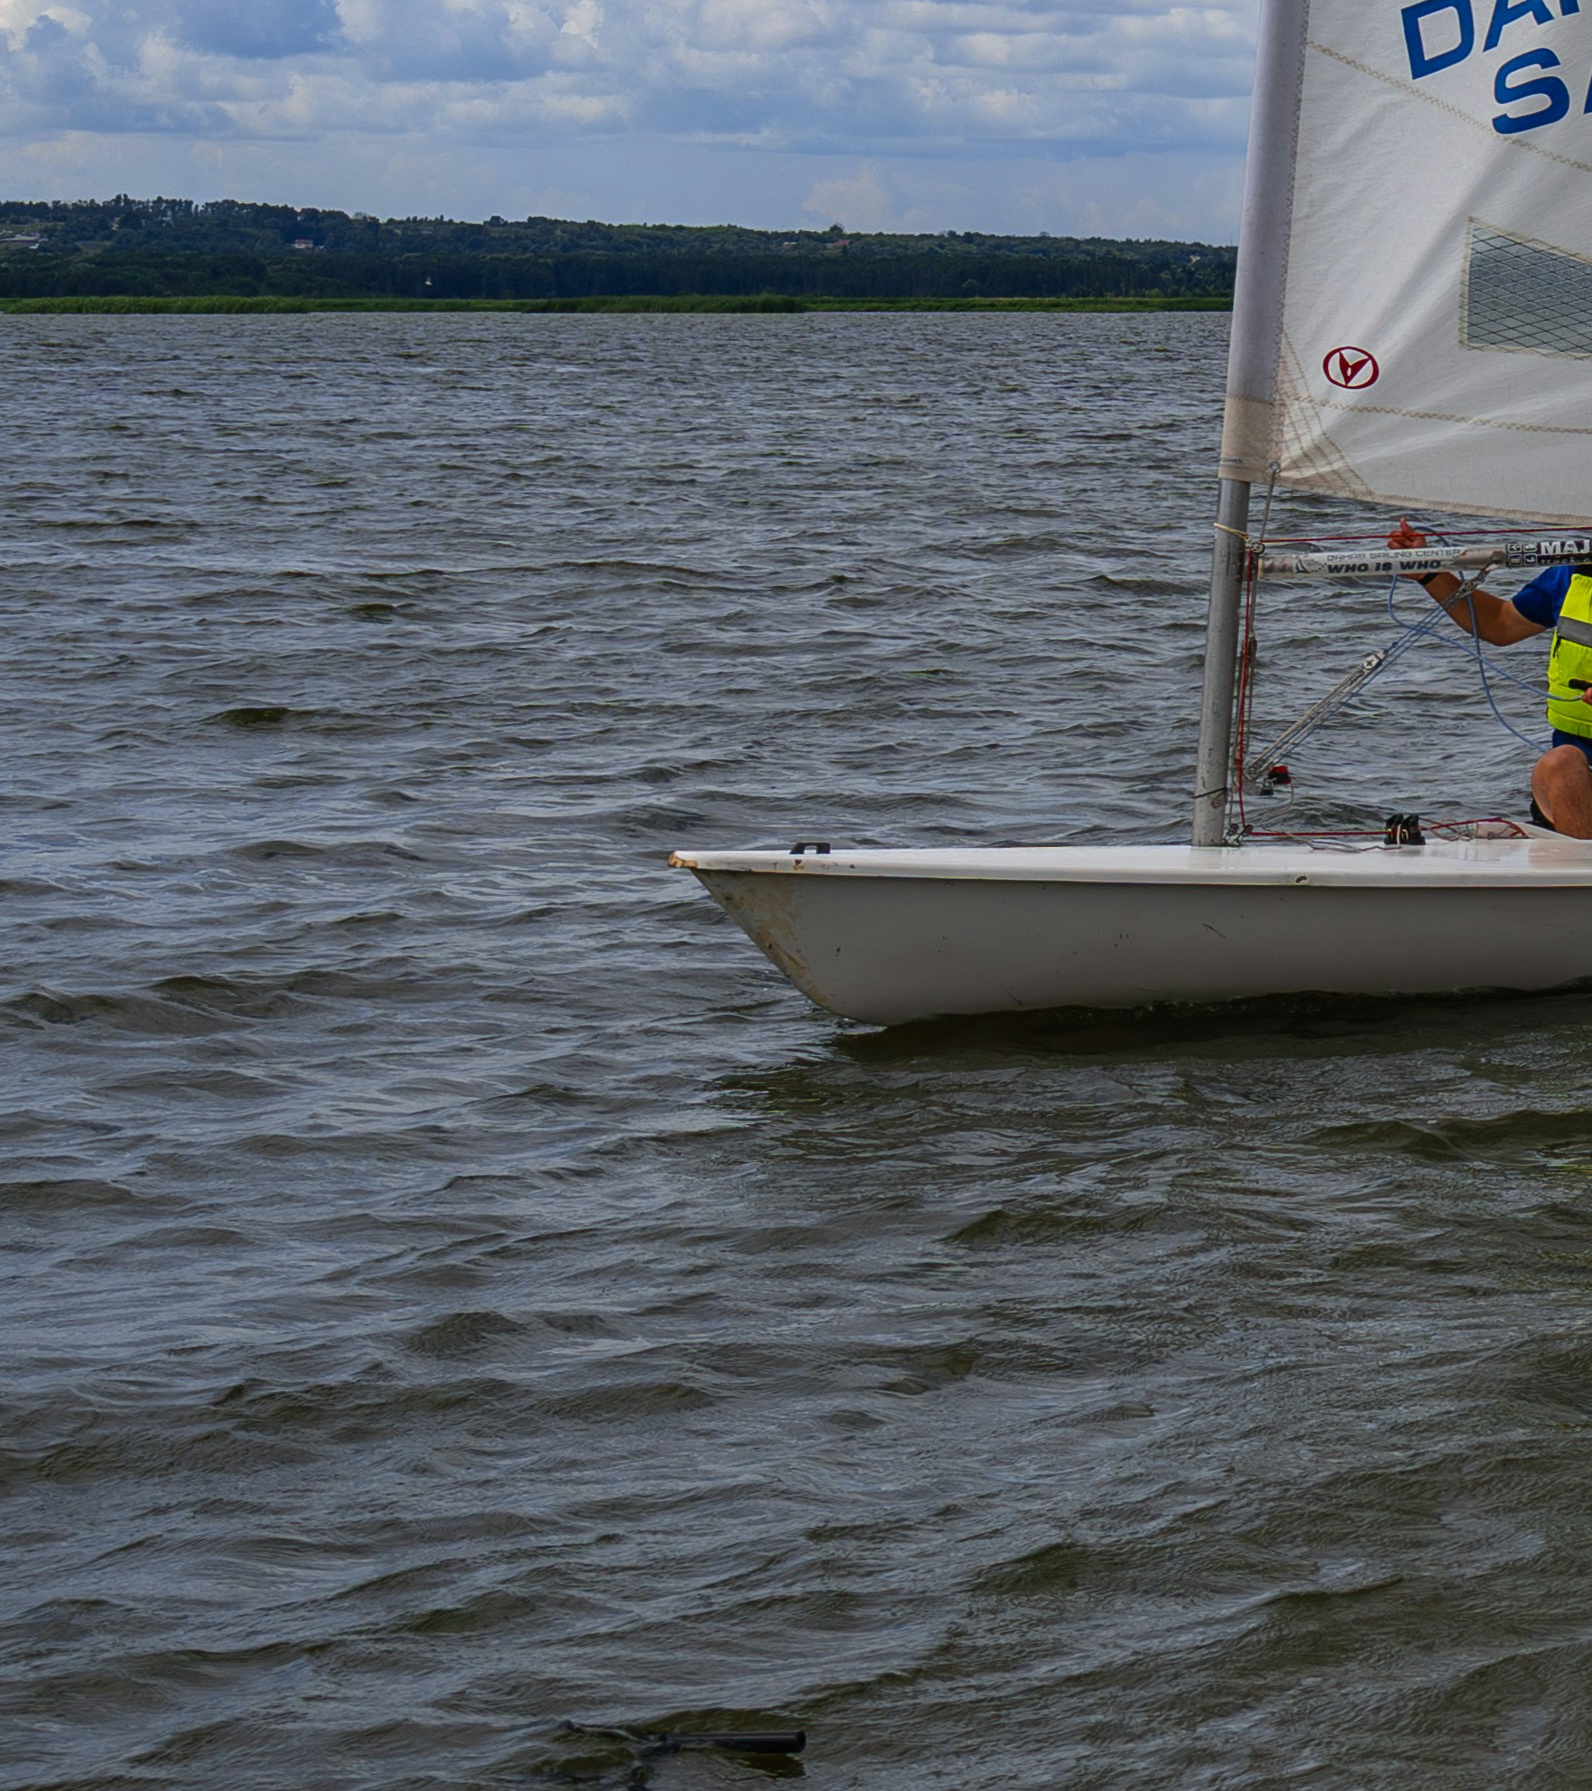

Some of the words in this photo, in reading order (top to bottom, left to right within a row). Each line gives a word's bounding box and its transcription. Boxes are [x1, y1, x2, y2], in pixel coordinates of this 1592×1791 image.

[1326, 552, 1367, 561] DAHAB
[1369, 550, 1413, 560] SAILING
[1415, 548, 1461, 559] CENTER
[1327, 562, 1370, 574] WHO
[1374, 561, 1393, 573] IS
[1399, 559, 1442, 572] WHO
